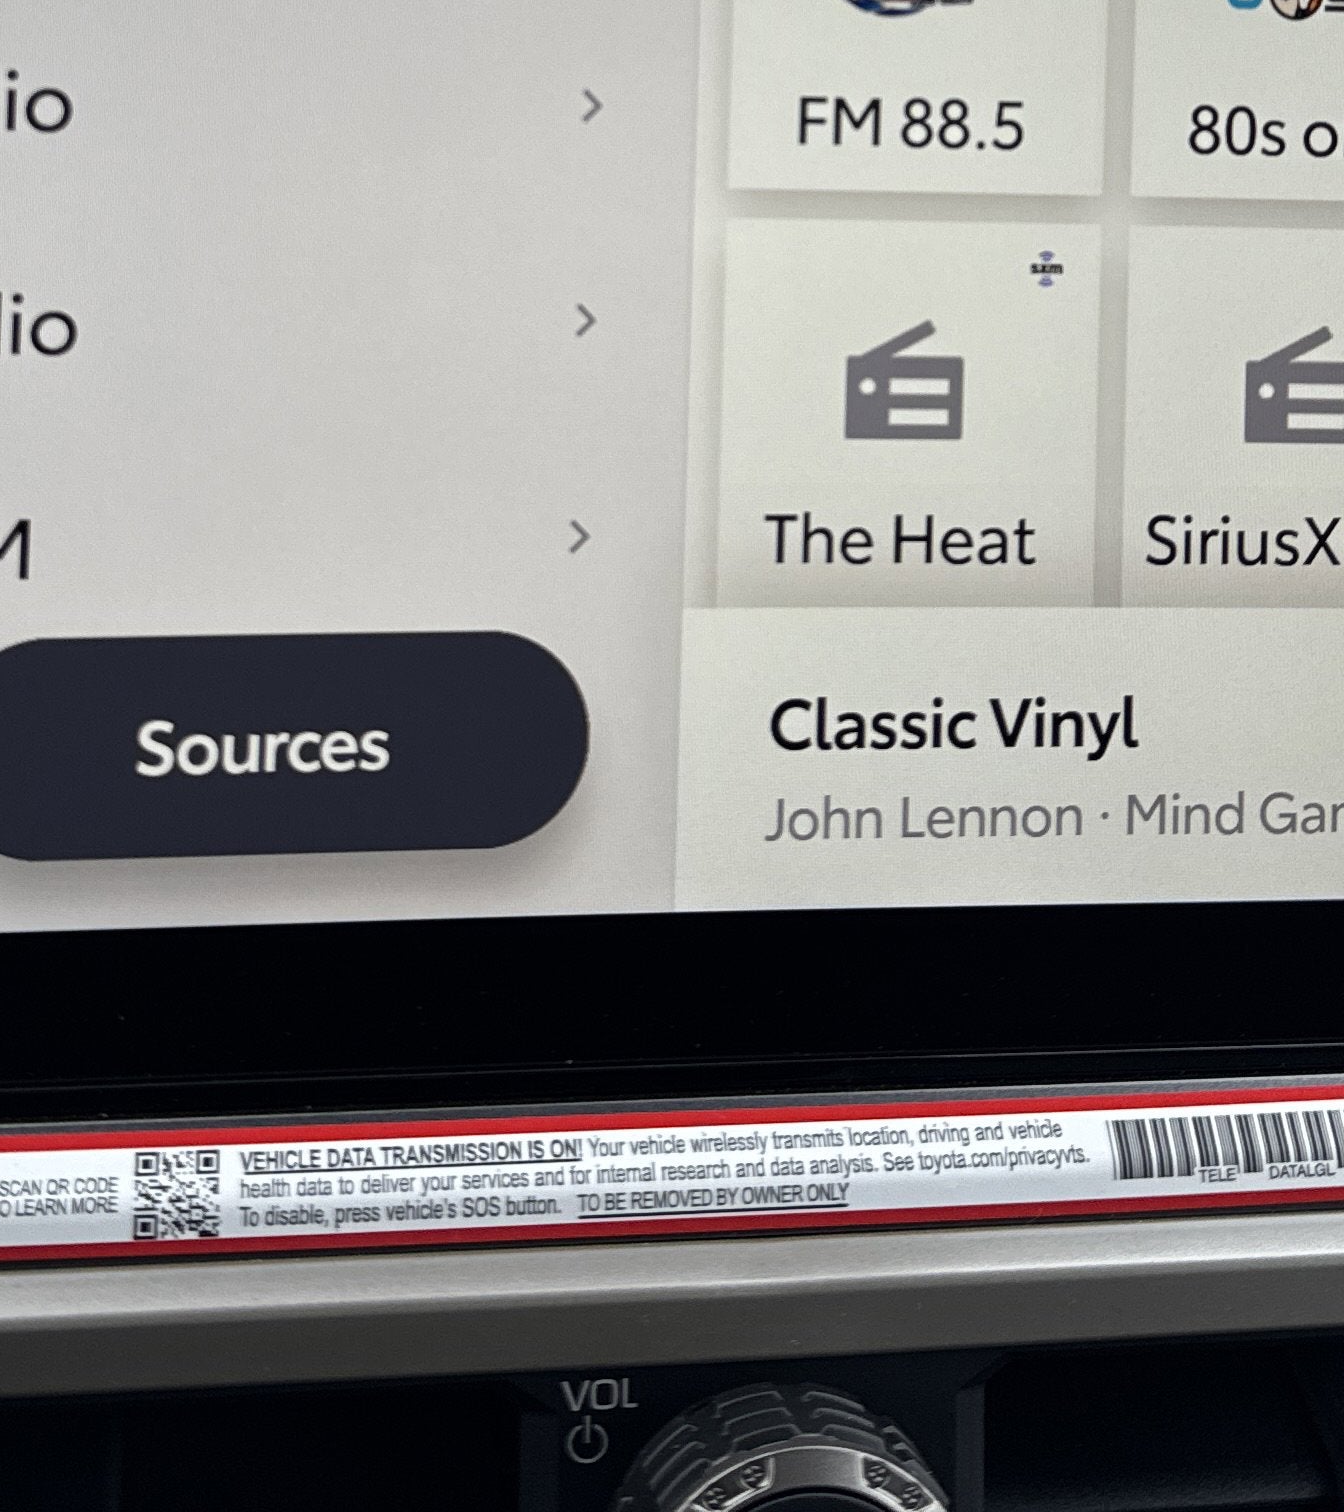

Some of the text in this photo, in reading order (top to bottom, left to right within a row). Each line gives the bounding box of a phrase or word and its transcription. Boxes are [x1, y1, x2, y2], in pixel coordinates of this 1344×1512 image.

[800, 97, 1022, 150] FM 88.5
[1189, 105, 1285, 156] 80s
[765, 512, 1035, 565] The Heat
[137, 721, 389, 776] Sources
[771, 696, 1138, 756] Classic Vinyl
[765, 795, 882, 841] John
[902, 797, 1082, 838] Lennon
[1127, 791, 1244, 835] Mind
[240, 1119, 1063, 1170] VEHICLE DATA TRANSMISSION IS ON! Your vehicle wirelessly transmits location, driving and vehicle
[46, 1178, 70, 1195] QR
[75, 1177, 118, 1194] CODE
[240, 1178, 291, 1198] health
[296, 1177, 332, 1196] data
[338, 1176, 355, 1195] to
[360, 1174, 416, 1194] deliver
[420, 1175, 457, 1197] your
[462, 1170, 529, 1189] services
[534, 1167, 564, 1186] and
[569, 1166, 592, 1185] for
[596, 1162, 657, 1184] internal
[661, 1159, 731, 1181] research
[736, 1158, 765, 1178] and
[770, 1156, 804, 1176] data
[809, 1152, 878, 1178] analysis.
[882, 1151, 915, 1172] See
[15, 1198, 67, 1217] LEARN
[71, 1196, 118, 1214] MORE
[240, 1182, 850, 1229] To disable, press vehicle's SOS button. TO BE REMOVED BY OWNER ONLY
[559, 1378, 639, 1412] VOL
